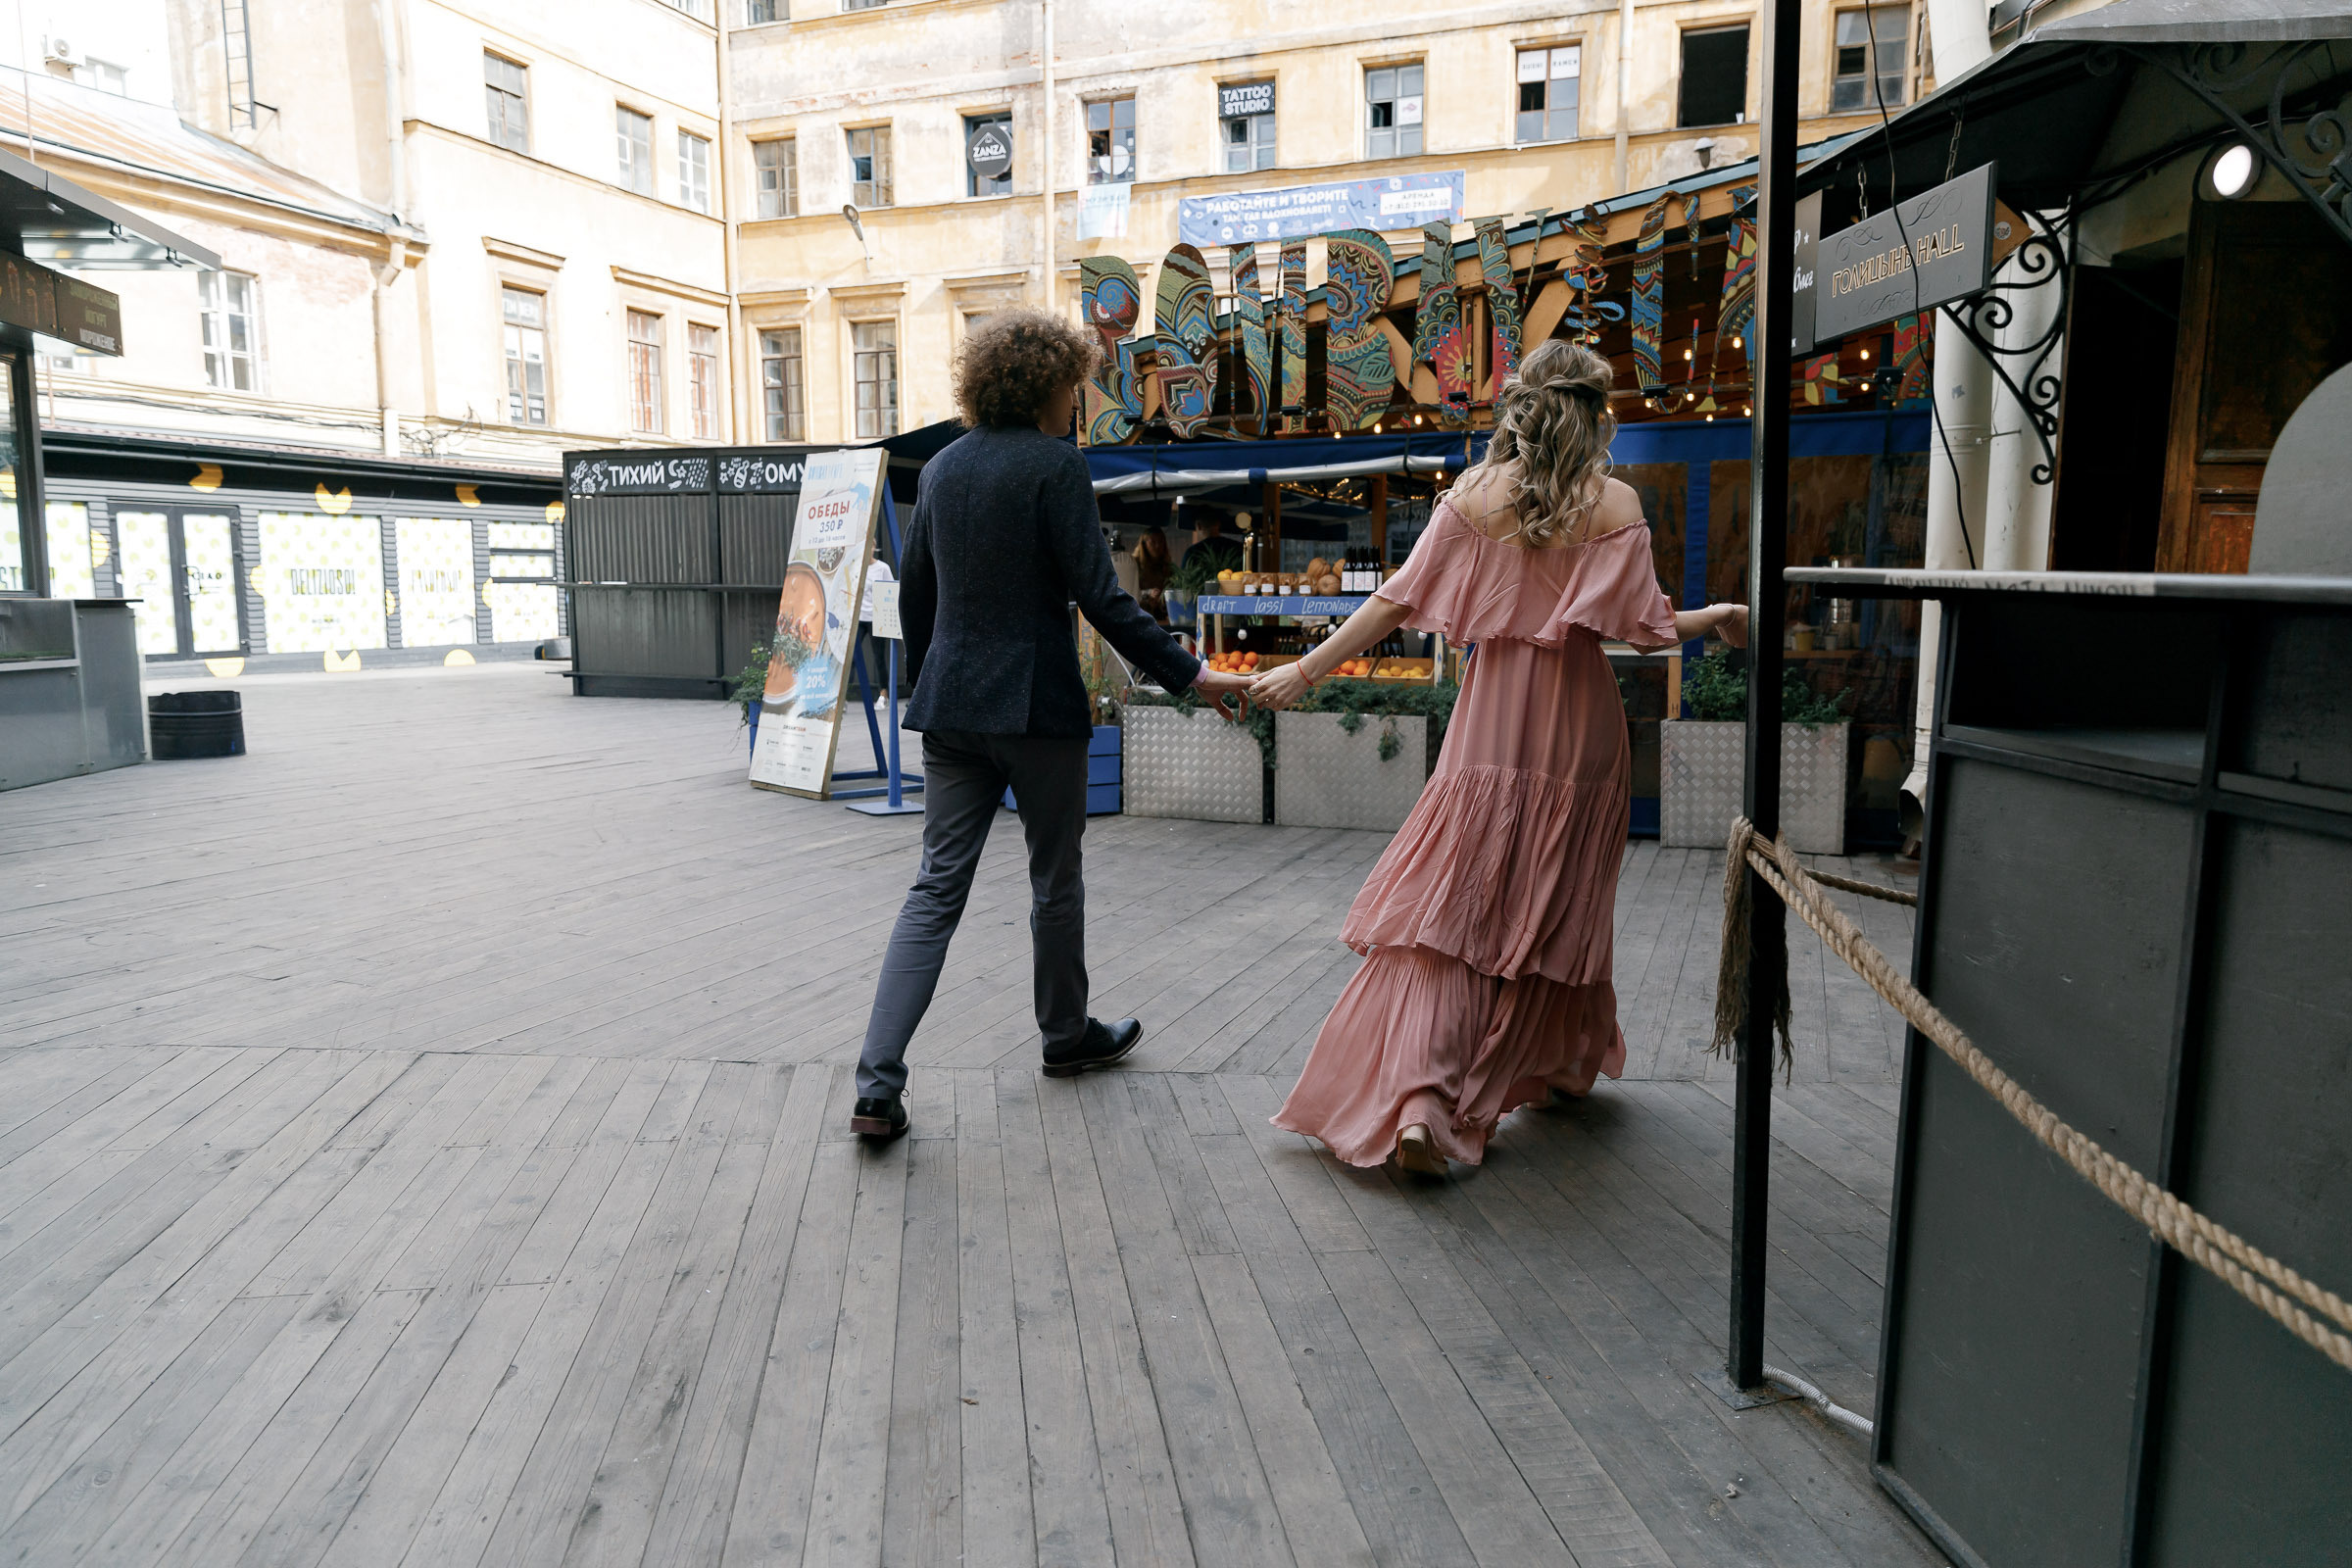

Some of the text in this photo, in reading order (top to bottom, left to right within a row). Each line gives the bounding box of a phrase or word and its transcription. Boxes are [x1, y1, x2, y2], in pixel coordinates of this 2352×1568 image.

[1222, 85, 1272, 102] TATTOO
[1225, 98, 1270, 115] STUDIO
[973, 144, 1006, 158] ZANZA
[1205, 188, 1349, 214] РАБОТАЙТЕ И ТВОРИТЕ
[1401, 191, 1435, 201] АРЕНДА
[1917, 223, 1964, 267] HALL
[608, 460, 665, 487] ТИХИЙ
[808, 501, 850, 519] ОБЕДЫ
[819, 520, 836, 533] 350
[291, 568, 356, 595] DELIZIOSO!
[806, 674, 826, 689] 20%
